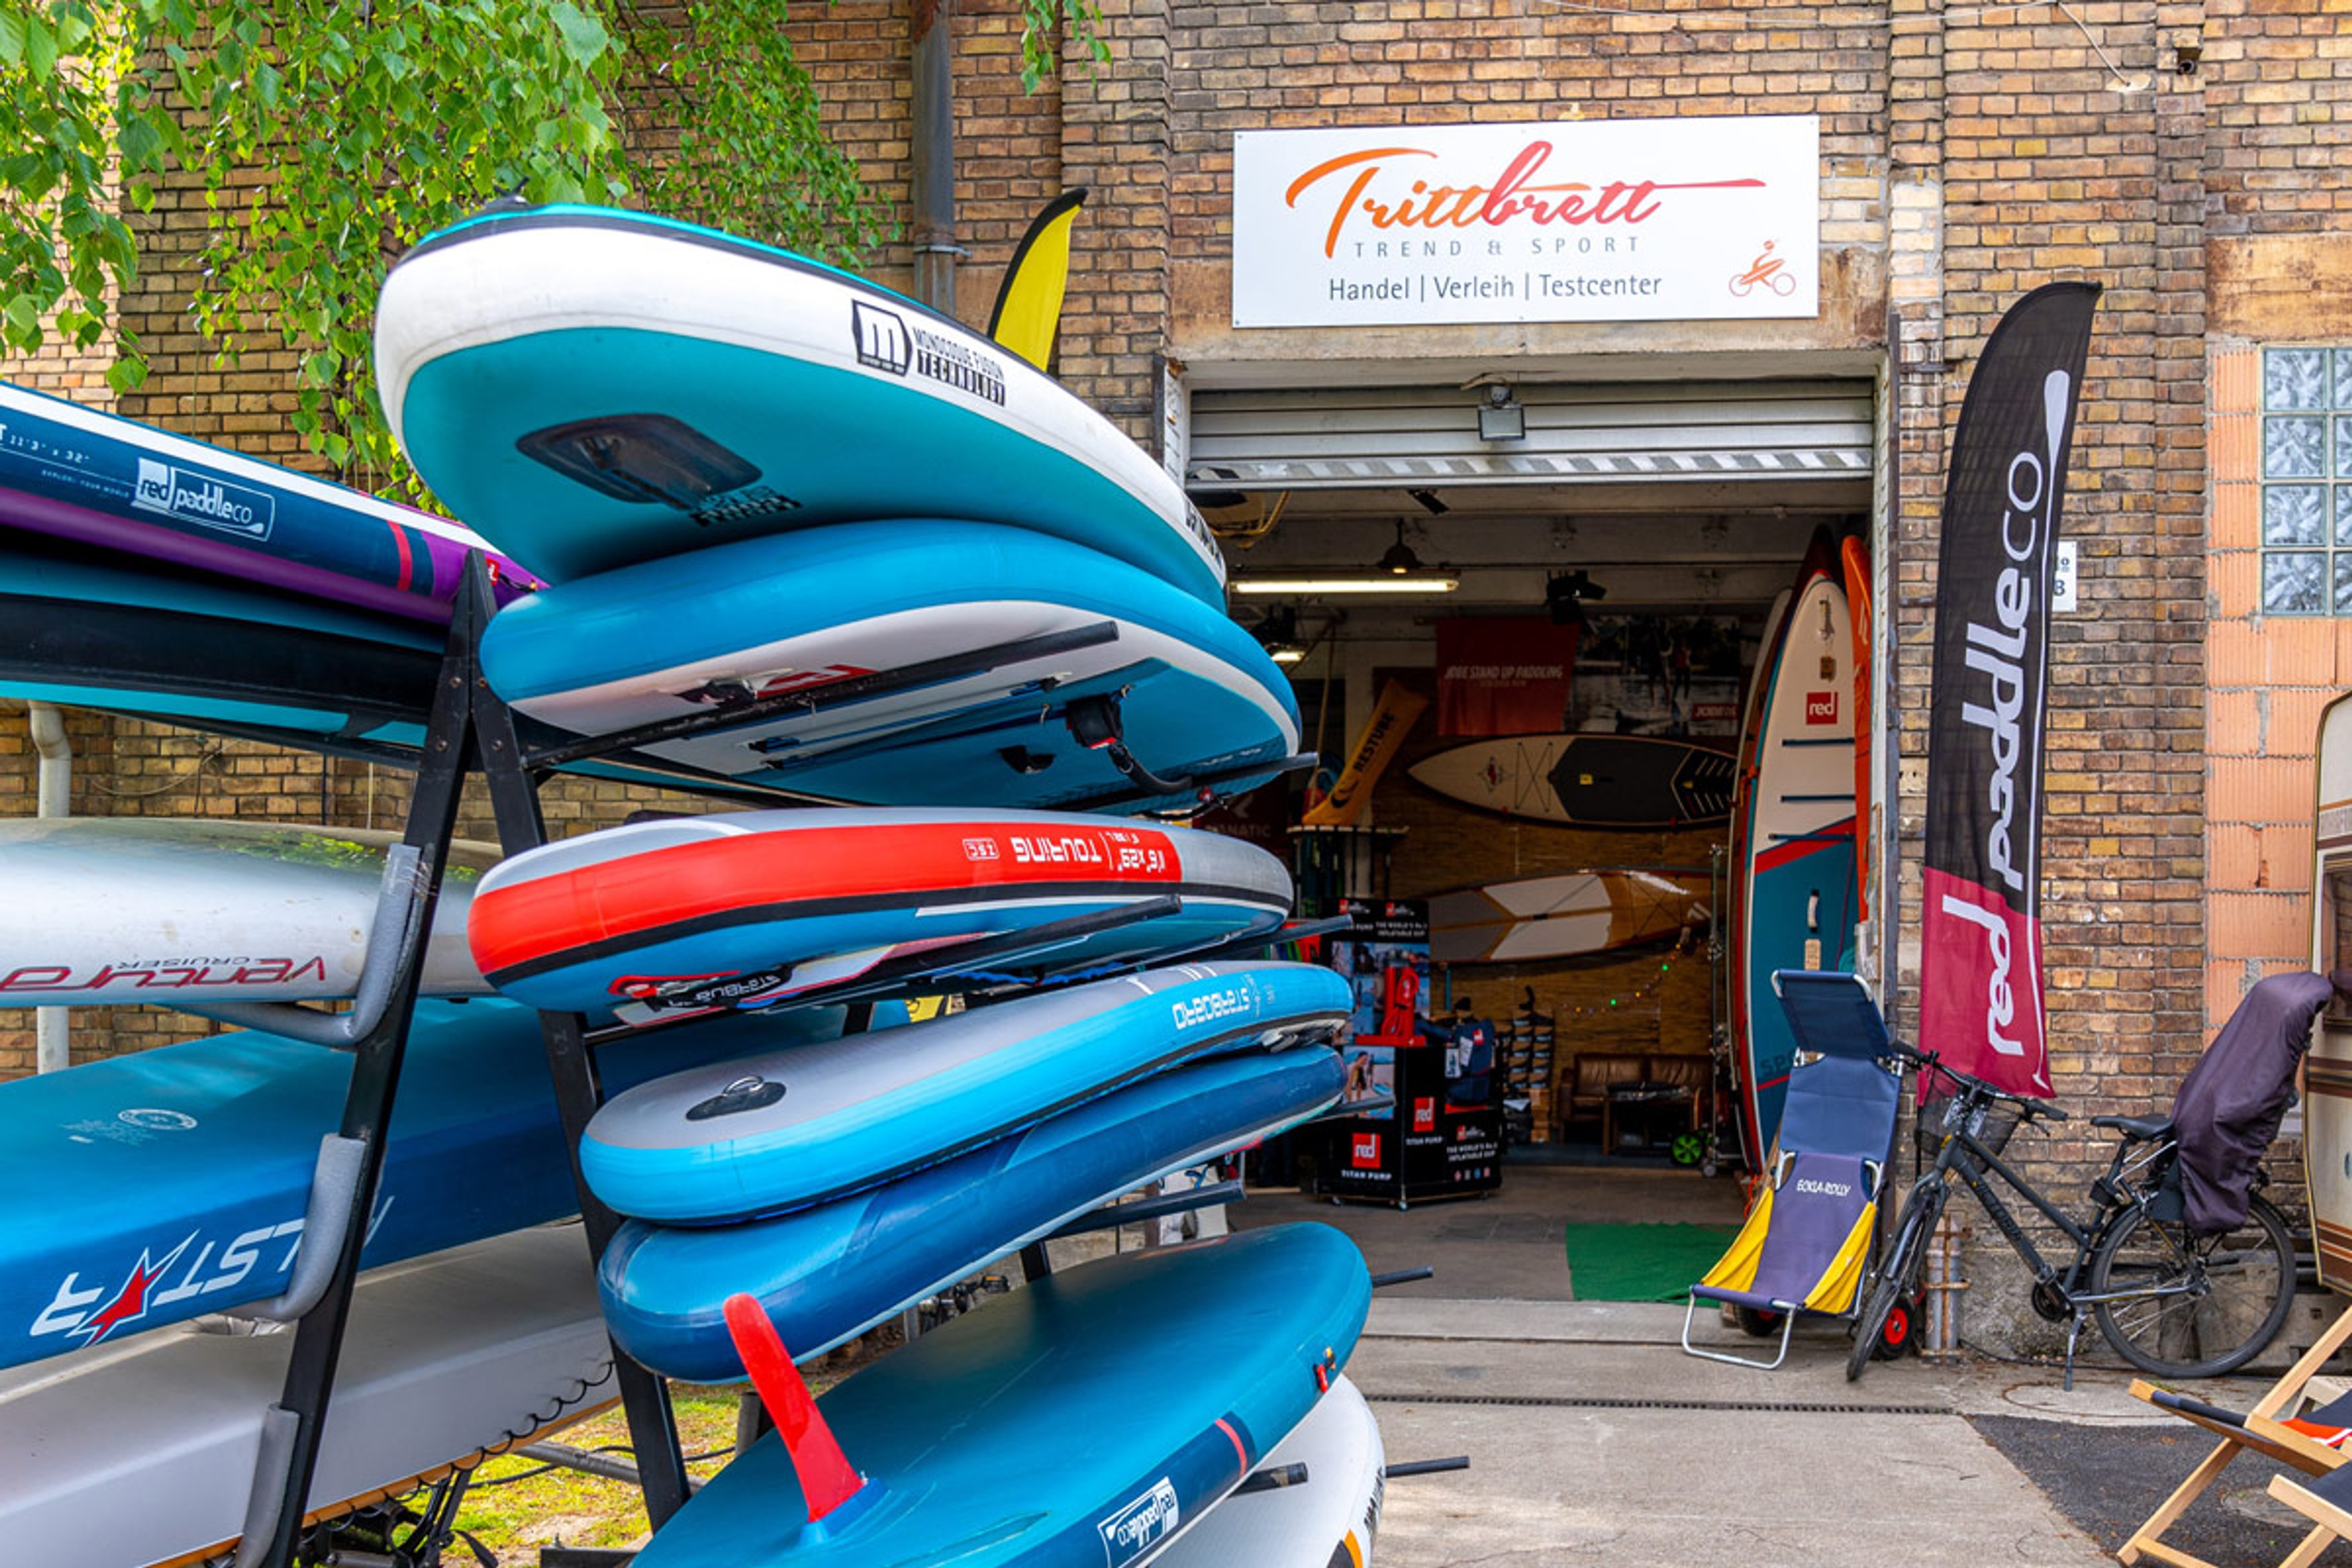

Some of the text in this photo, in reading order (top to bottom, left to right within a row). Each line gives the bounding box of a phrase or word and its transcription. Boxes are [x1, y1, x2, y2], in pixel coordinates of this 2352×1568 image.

[1285, 140, 1766, 258] Trittbrett
[1355, 237, 1640, 258] TREND & SPORT
[1329, 277, 1409, 301] Handel
[1434, 275, 1515, 299] Verleih
[1539, 273, 1662, 297] Testcenter
[1809, 692, 1835, 716] red
[1353, 710, 1395, 773] RESTUBE
[1011, 837, 1103, 863] TOURING
[118, 956, 251, 969] CRUISER
[1942, 894, 2024, 1056] red
[1415, 1096, 1435, 1122] red
[1355, 1133, 1376, 1159] red
[1340, 1169, 1393, 1181] TITAN PUMP
